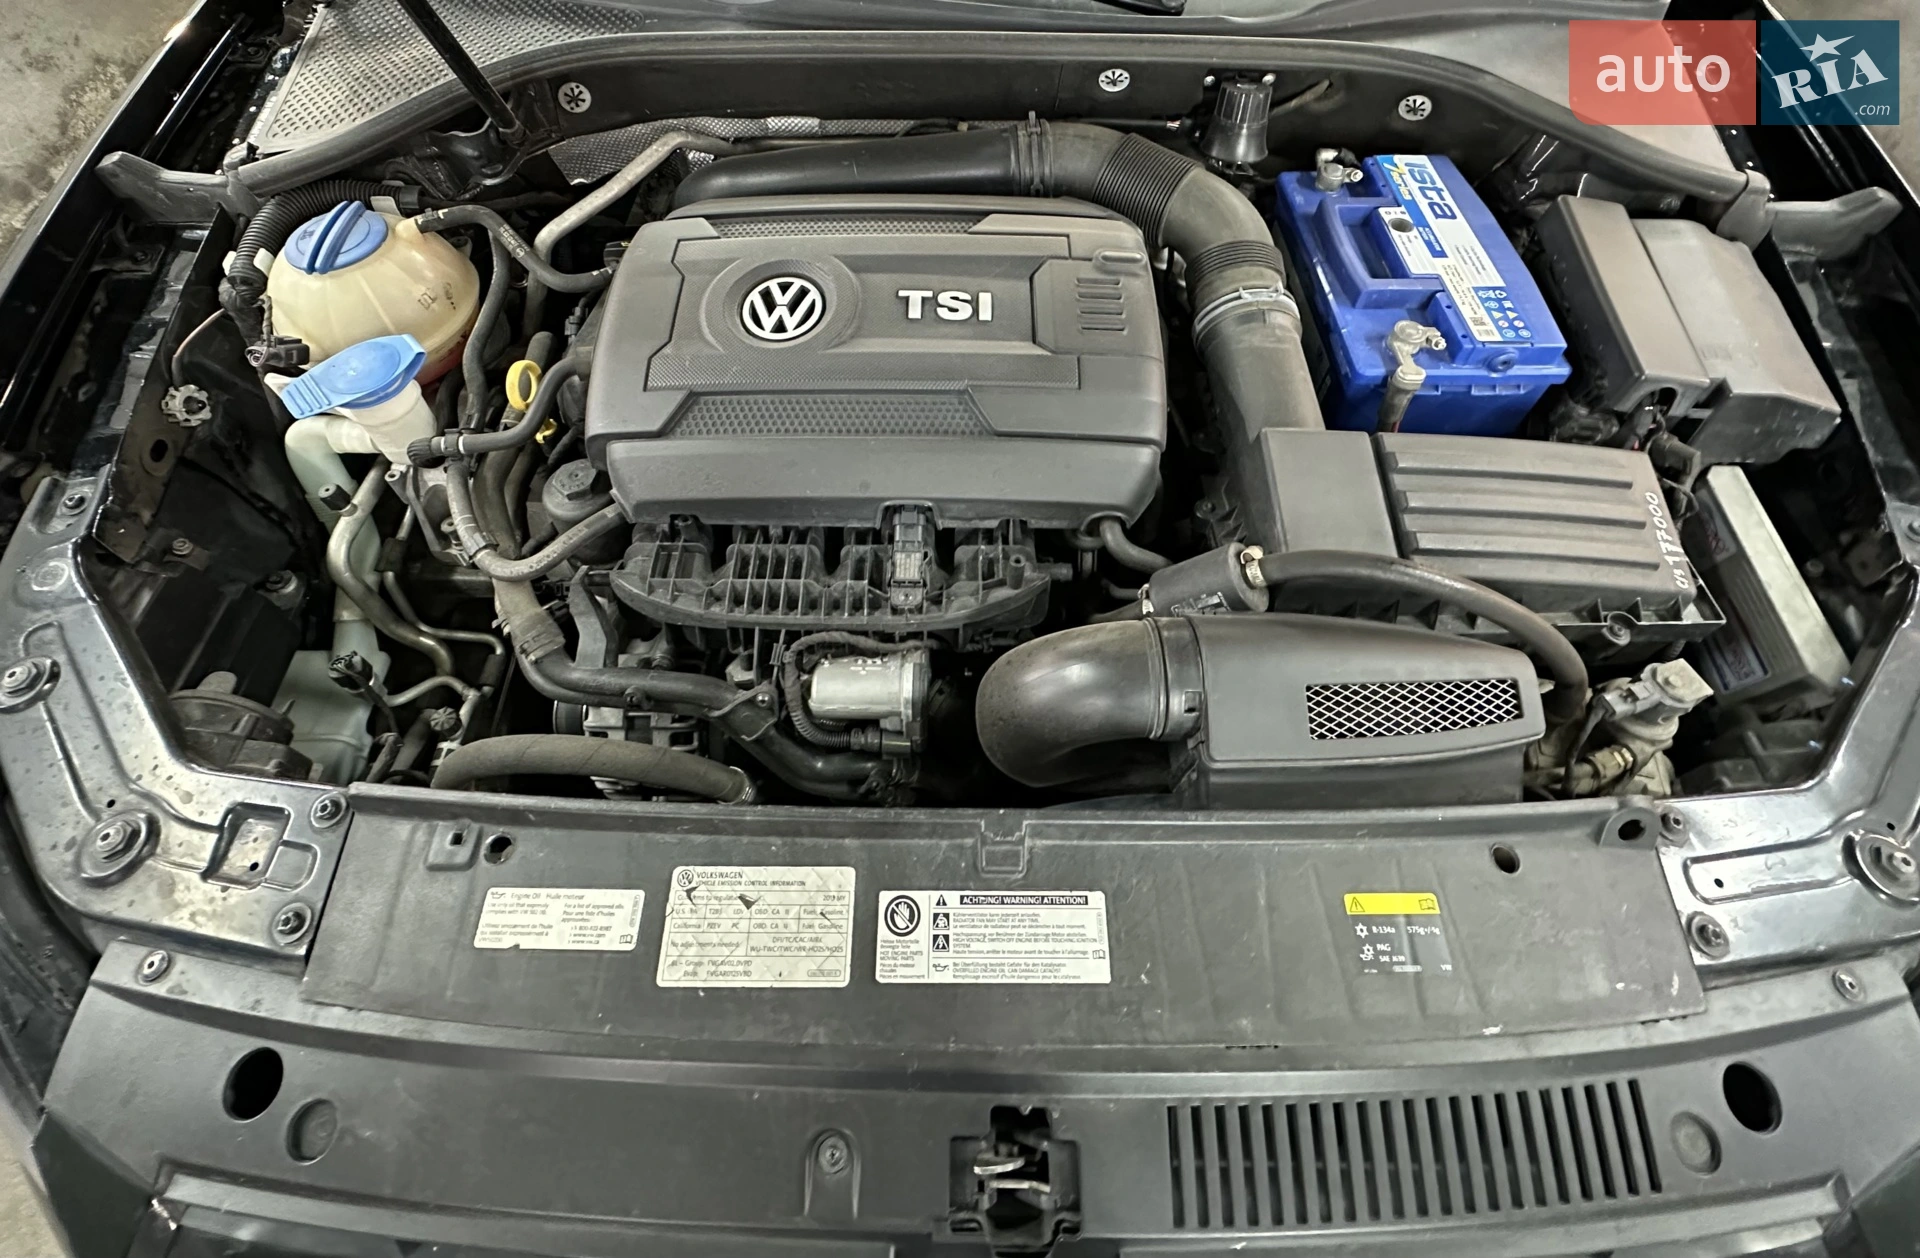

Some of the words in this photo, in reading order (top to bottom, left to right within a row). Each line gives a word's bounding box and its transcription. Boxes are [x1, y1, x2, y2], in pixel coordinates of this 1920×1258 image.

[741, 276, 823, 340] VW
[898, 289, 993, 321] TSI
[511, 892, 531, 901] Engine
[532, 892, 541, 900] Oil
[546, 892, 562, 900] Huile
[1003, 896, 1041, 904] WARNING!
[1043, 896, 1086, 904] ATTENTION!
[1376, 943, 1391, 952] PAG
